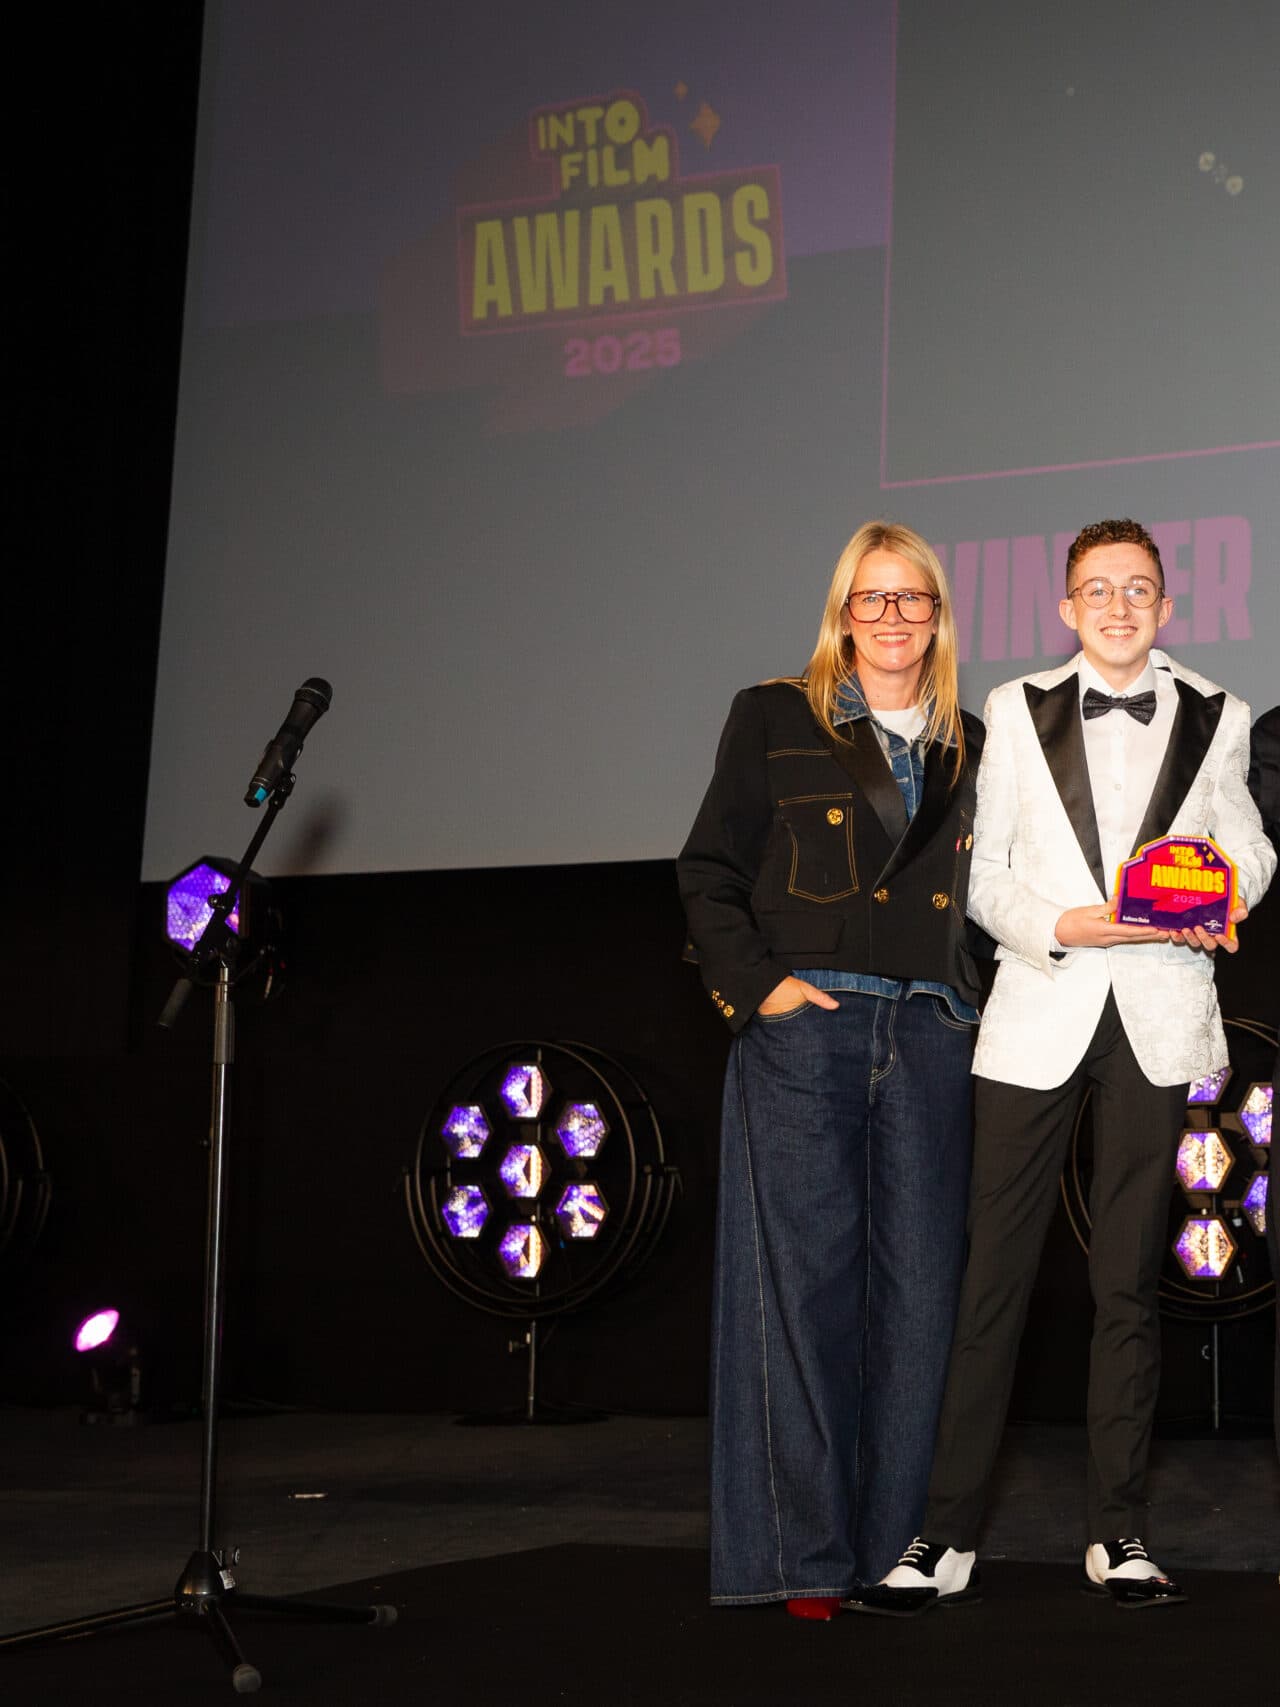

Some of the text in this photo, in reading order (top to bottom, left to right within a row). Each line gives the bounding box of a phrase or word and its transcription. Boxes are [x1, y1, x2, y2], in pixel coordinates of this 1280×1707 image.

[538, 100, 641, 151] INTO
[561, 136, 671, 190] FILM
[472, 184, 774, 320] AWARDS
[564, 328, 682, 377] 2025
[931, 515, 1252, 664] INER
[1169, 845, 1196, 856] INTO
[1174, 855, 1202, 866] FILM
[1151, 865, 1225, 893] AWARDS
[1172, 893, 1202, 905] 2025
